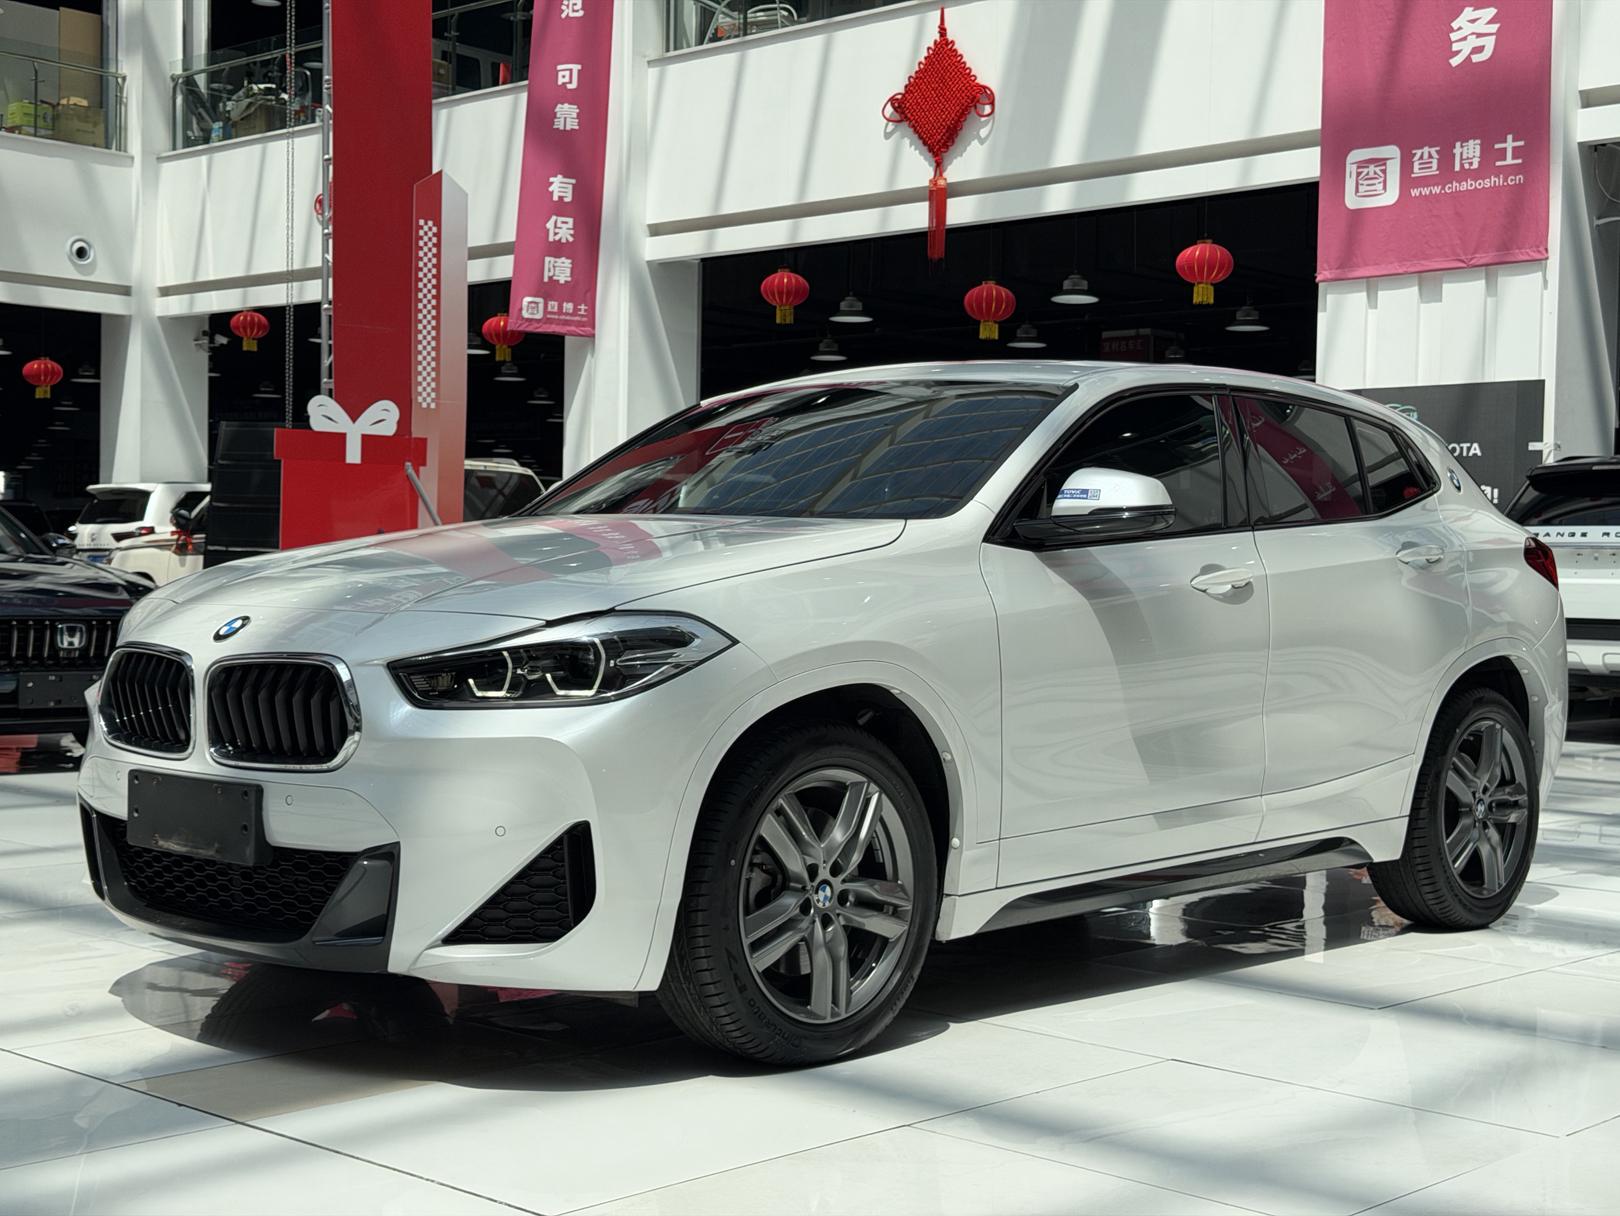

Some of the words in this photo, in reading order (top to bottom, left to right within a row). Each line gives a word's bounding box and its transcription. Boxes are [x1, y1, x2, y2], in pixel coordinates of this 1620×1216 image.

[1449, 6, 1501, 68] 务
[553, 63, 582, 131] 可靠
[1410, 174, 1524, 197] www.chaboshi.cn
[1411, 134, 1525, 178] 查博士
[543, 174, 577, 285] 有保障
